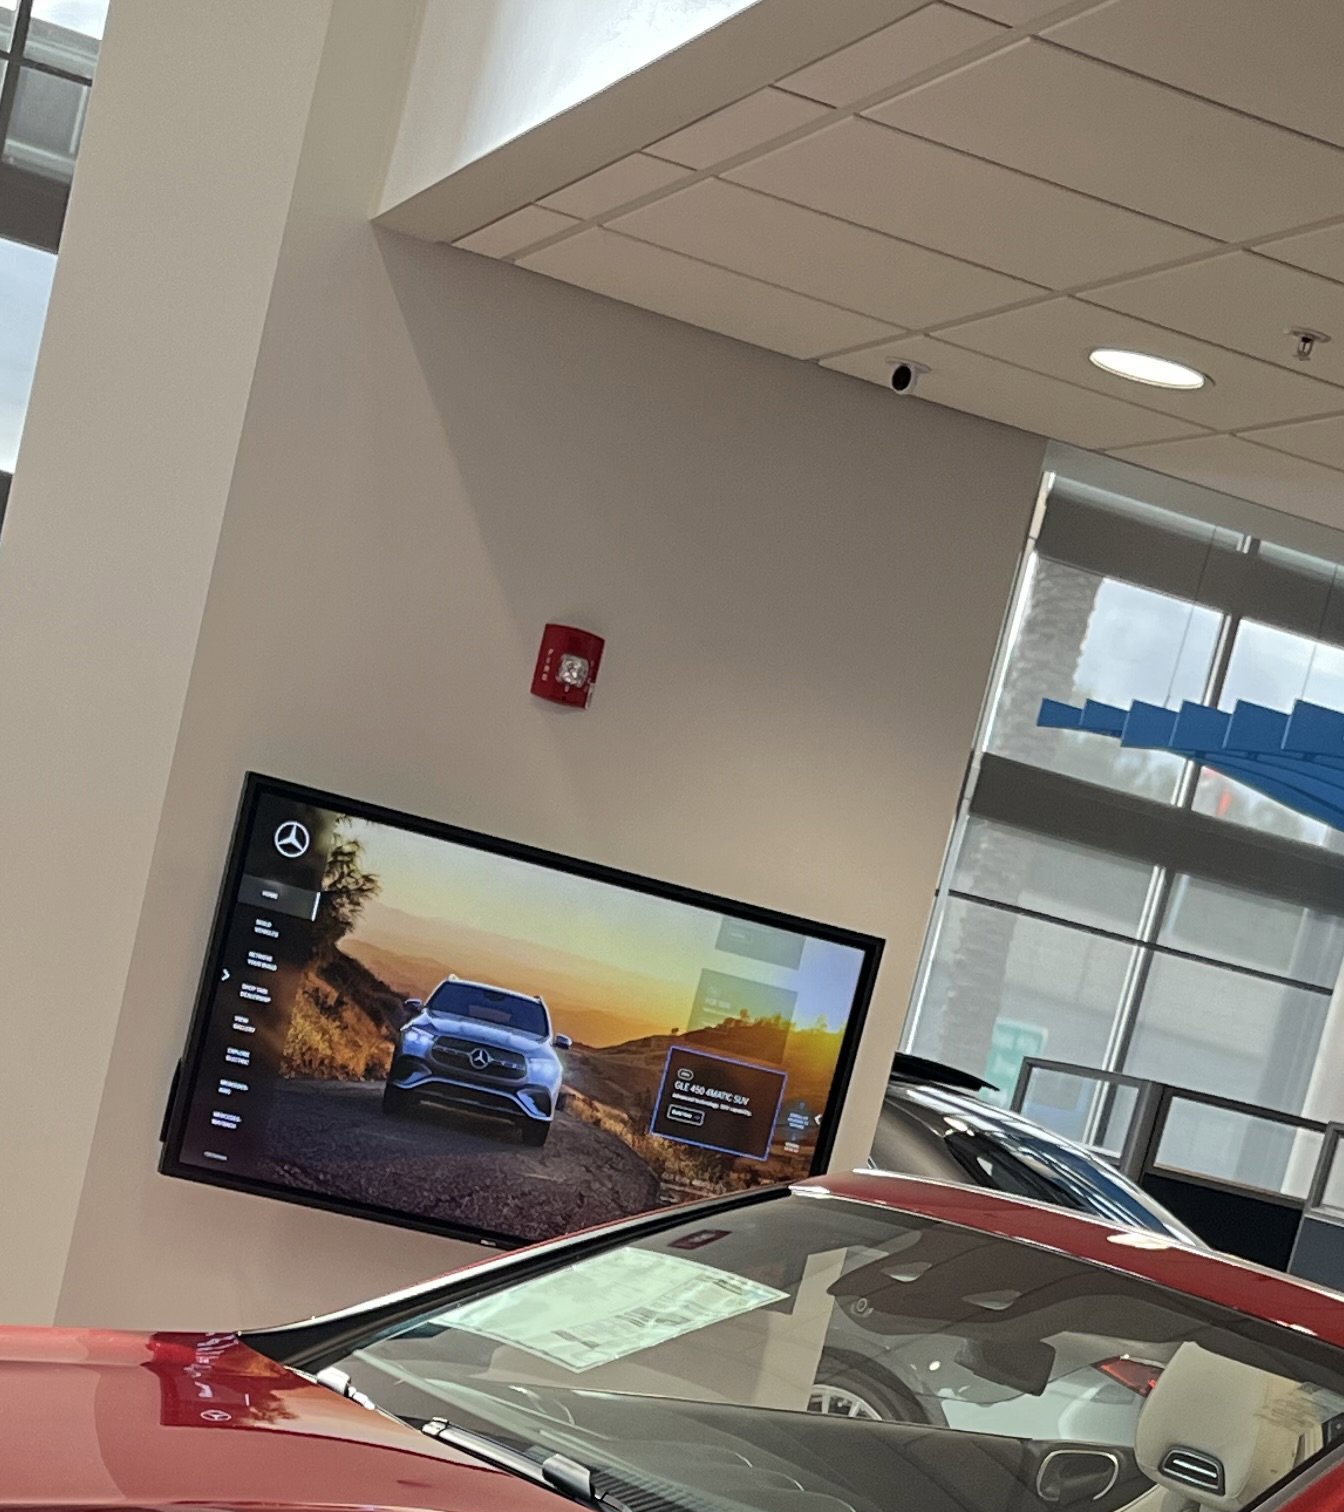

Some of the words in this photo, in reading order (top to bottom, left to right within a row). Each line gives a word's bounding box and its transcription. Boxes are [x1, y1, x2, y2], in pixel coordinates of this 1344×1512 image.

[674, 1080, 689, 1093] GLE
[689, 1084, 706, 1096] 450
[705, 1087, 734, 1102] 4MATIC
[732, 1094, 750, 1106] SUV
